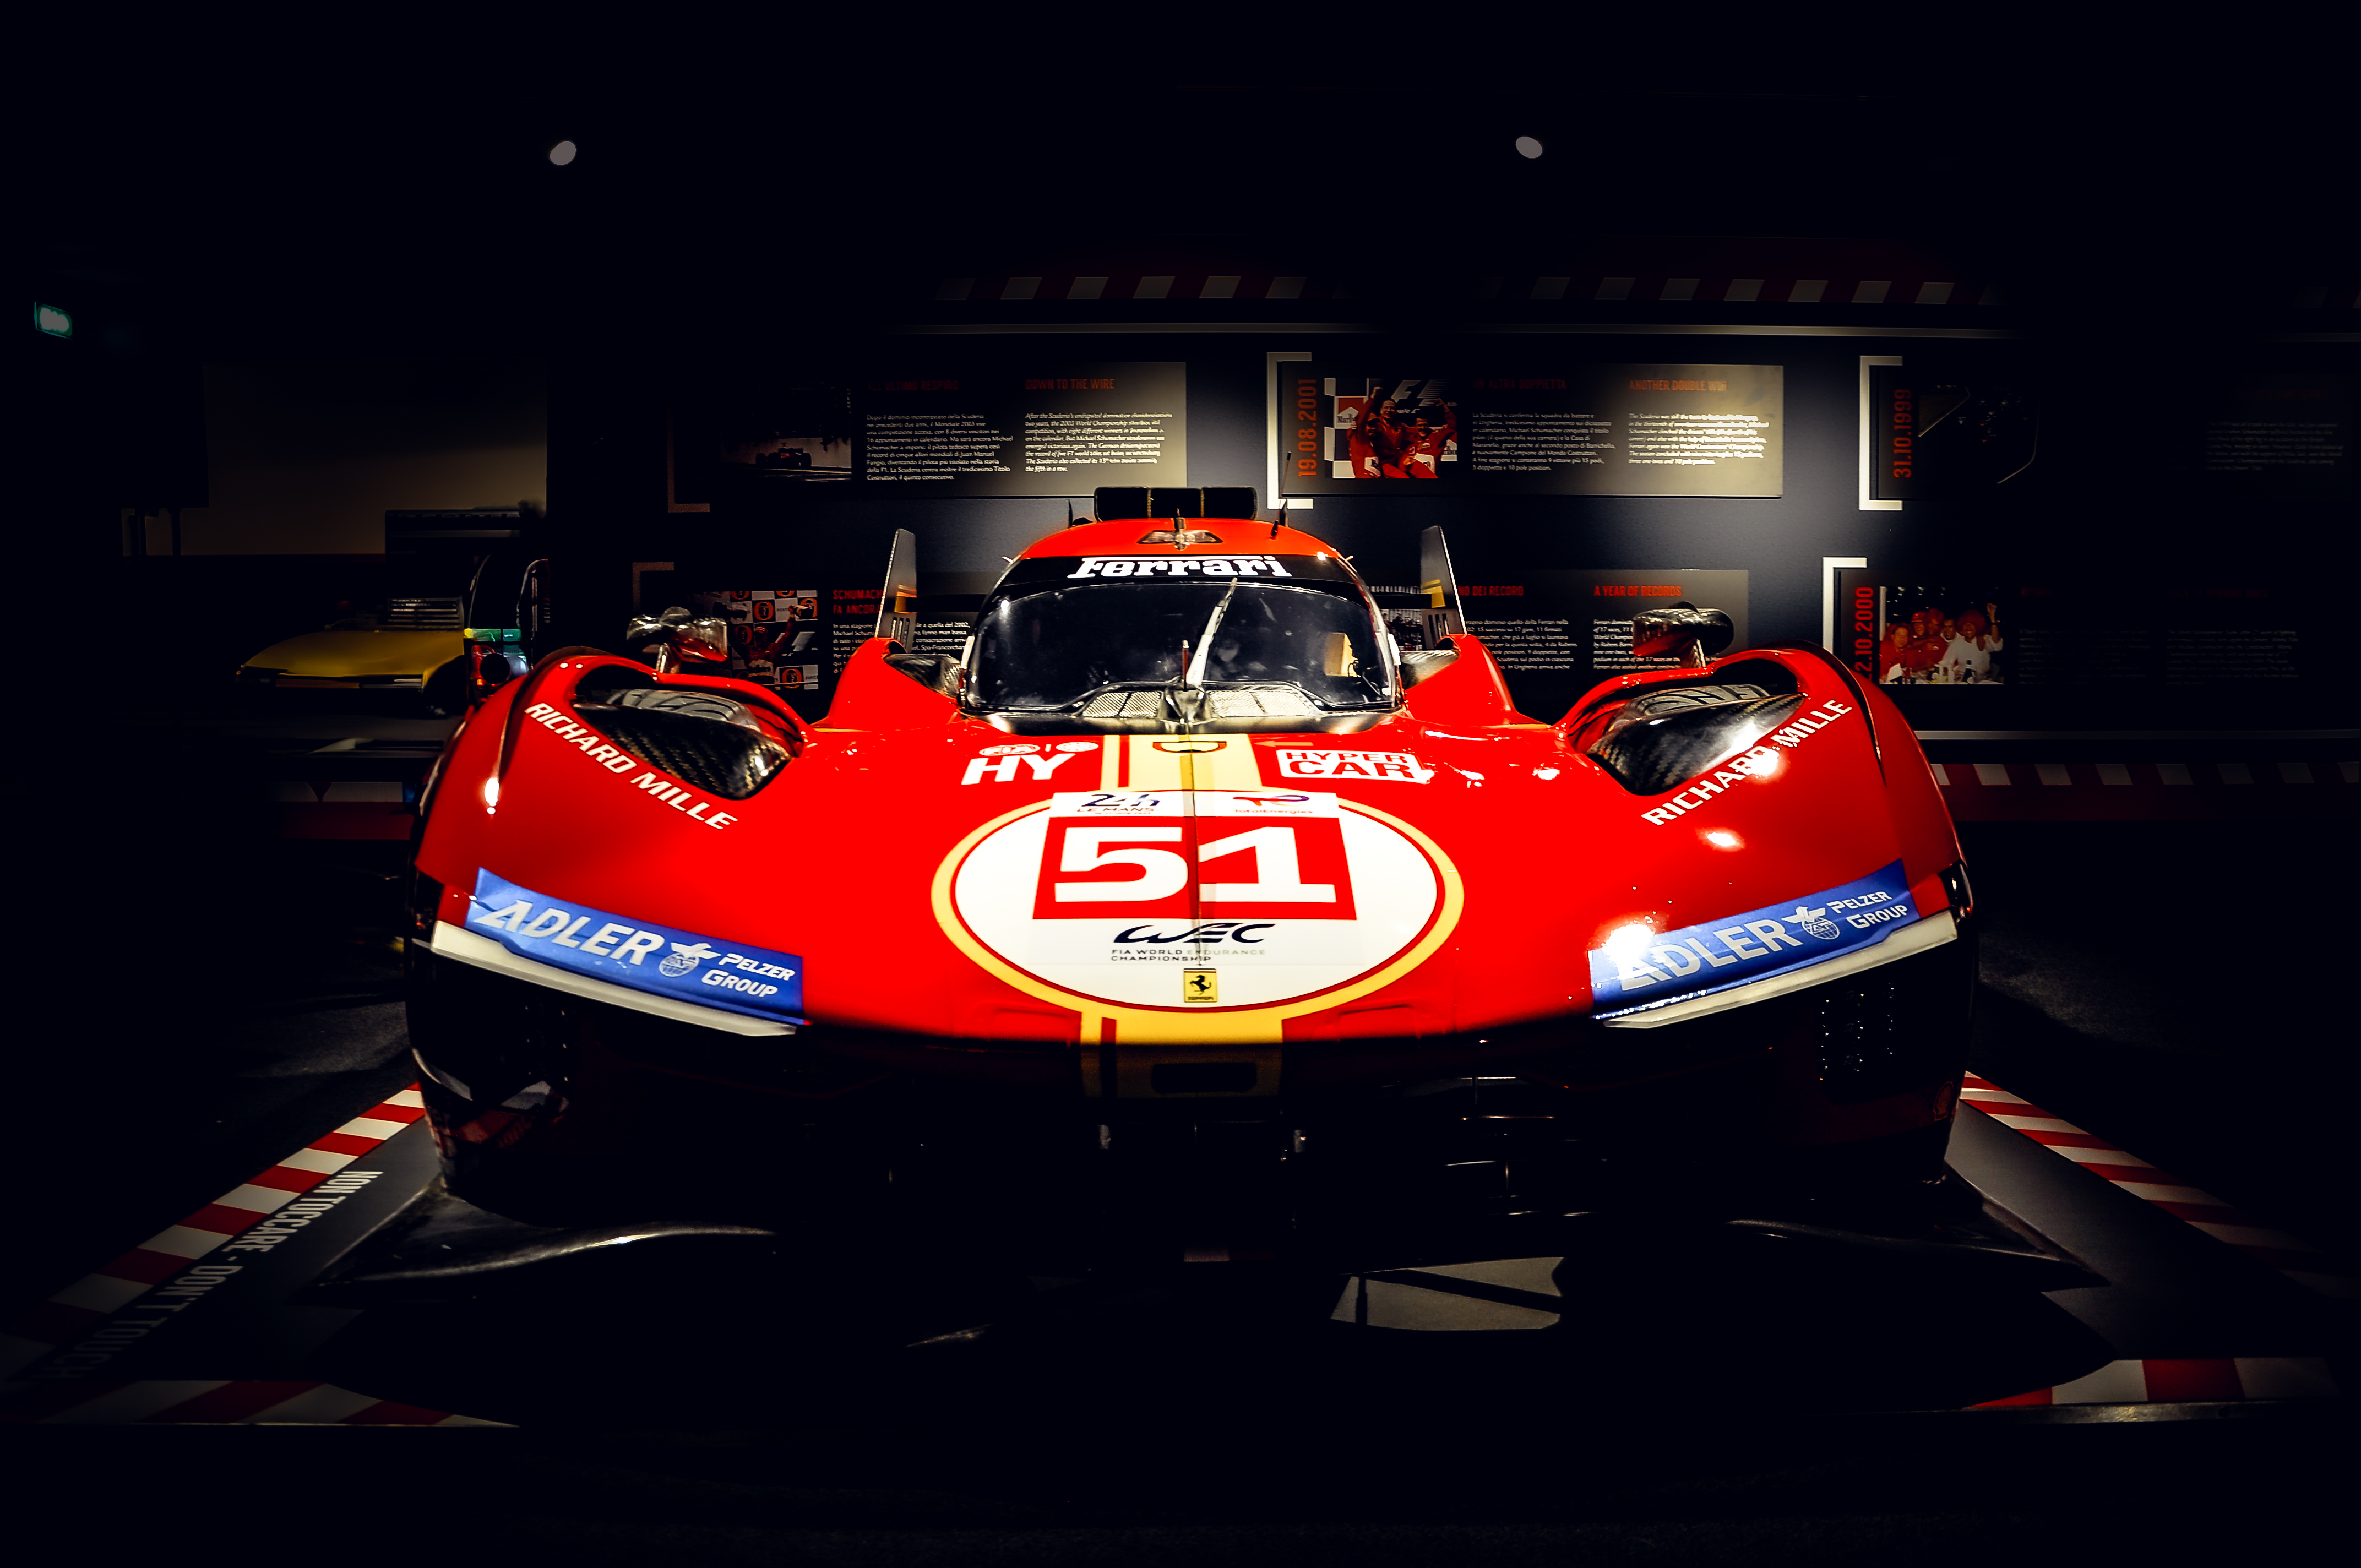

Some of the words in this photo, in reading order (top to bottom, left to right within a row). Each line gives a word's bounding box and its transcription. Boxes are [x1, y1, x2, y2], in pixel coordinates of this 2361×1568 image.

[1026, 379, 1054, 389] DOWN
[1056, 379, 1068, 389] TO
[1070, 379, 1088, 389] THE
[1090, 379, 1115, 389] WIRE
[1518, 379, 1567, 389] DOPPIETTA
[1629, 380, 1671, 390] ANOTHER
[1672, 380, 1706, 391] DOUBLE
[1298, 379, 1318, 477] 19.08.2001
[1893, 388, 1913, 478] 31.10.1999
[1067, 555, 1293, 579] Ferrari
[1472, 585, 1487, 596] DEI
[1488, 585, 1525, 596] RECORD
[1594, 586, 1601, 596] A
[1602, 586, 1626, 596] YEAR
[1628, 585, 1639, 596] OF
[1641, 585, 1682, 597] RECORDS
[524, 702, 637, 774] RICHARD
[630, 772, 738, 830] MILLE
[961, 753, 1076, 785] HY
[1285, 752, 1410, 764] HYPER
[1288, 760, 1416, 779] CAR
[1640, 745, 1780, 826] RICHARD
[1770, 700, 1853, 748] MILLE
[1054, 826, 1337, 903] 51
[1827, 890, 1892, 914] PELZER
[1847, 904, 1908, 930] GROUP
[473, 899, 665, 966] ADLER
[1113, 922, 1276, 944] WEC
[718, 952, 795, 981] PELZER
[1620, 918, 1803, 992] ADLER
[701, 968, 778, 998] GROUP
[312, 1170, 384, 1194] NON
[221, 1195, 347, 1253] TOCCARE
[134, 1265, 244, 1312] DON'T
[27, 1316, 169, 1379] TOUCH
